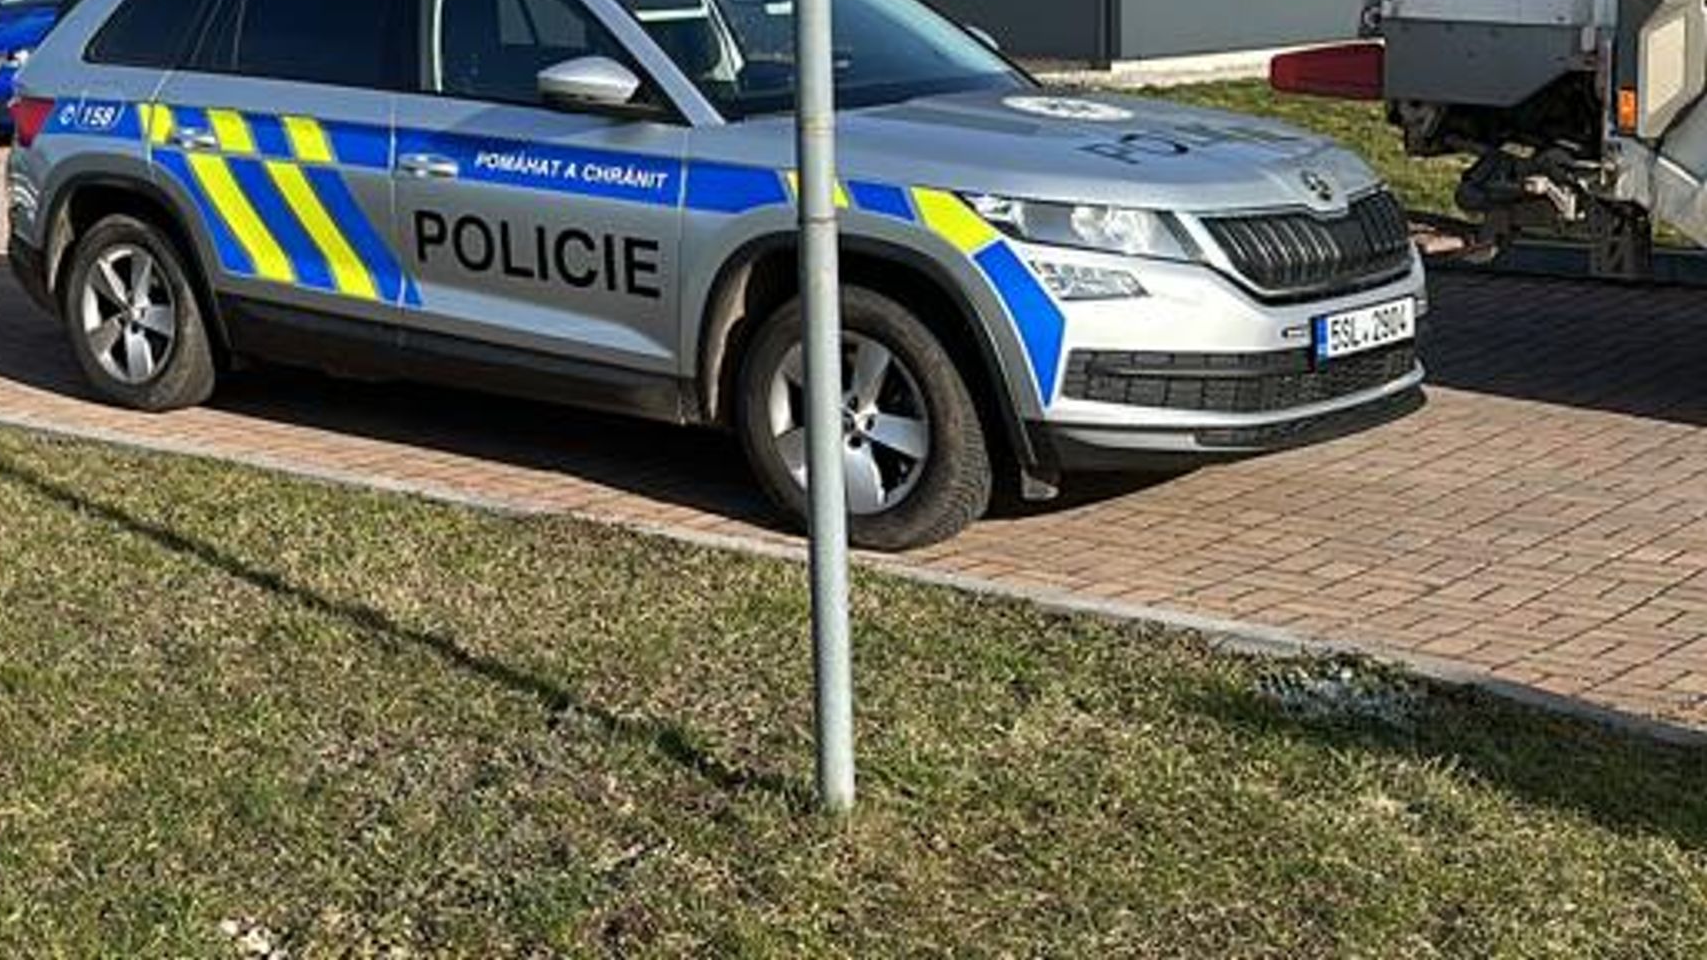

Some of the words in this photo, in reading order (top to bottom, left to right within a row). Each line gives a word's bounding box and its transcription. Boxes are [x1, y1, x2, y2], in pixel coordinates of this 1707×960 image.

[82, 106, 115, 126] 158
[474, 150, 562, 178] POMÁHAT
[563, 162, 578, 179] A
[581, 162, 669, 190] CHRÁNIT
[412, 209, 662, 299] POLICIE
